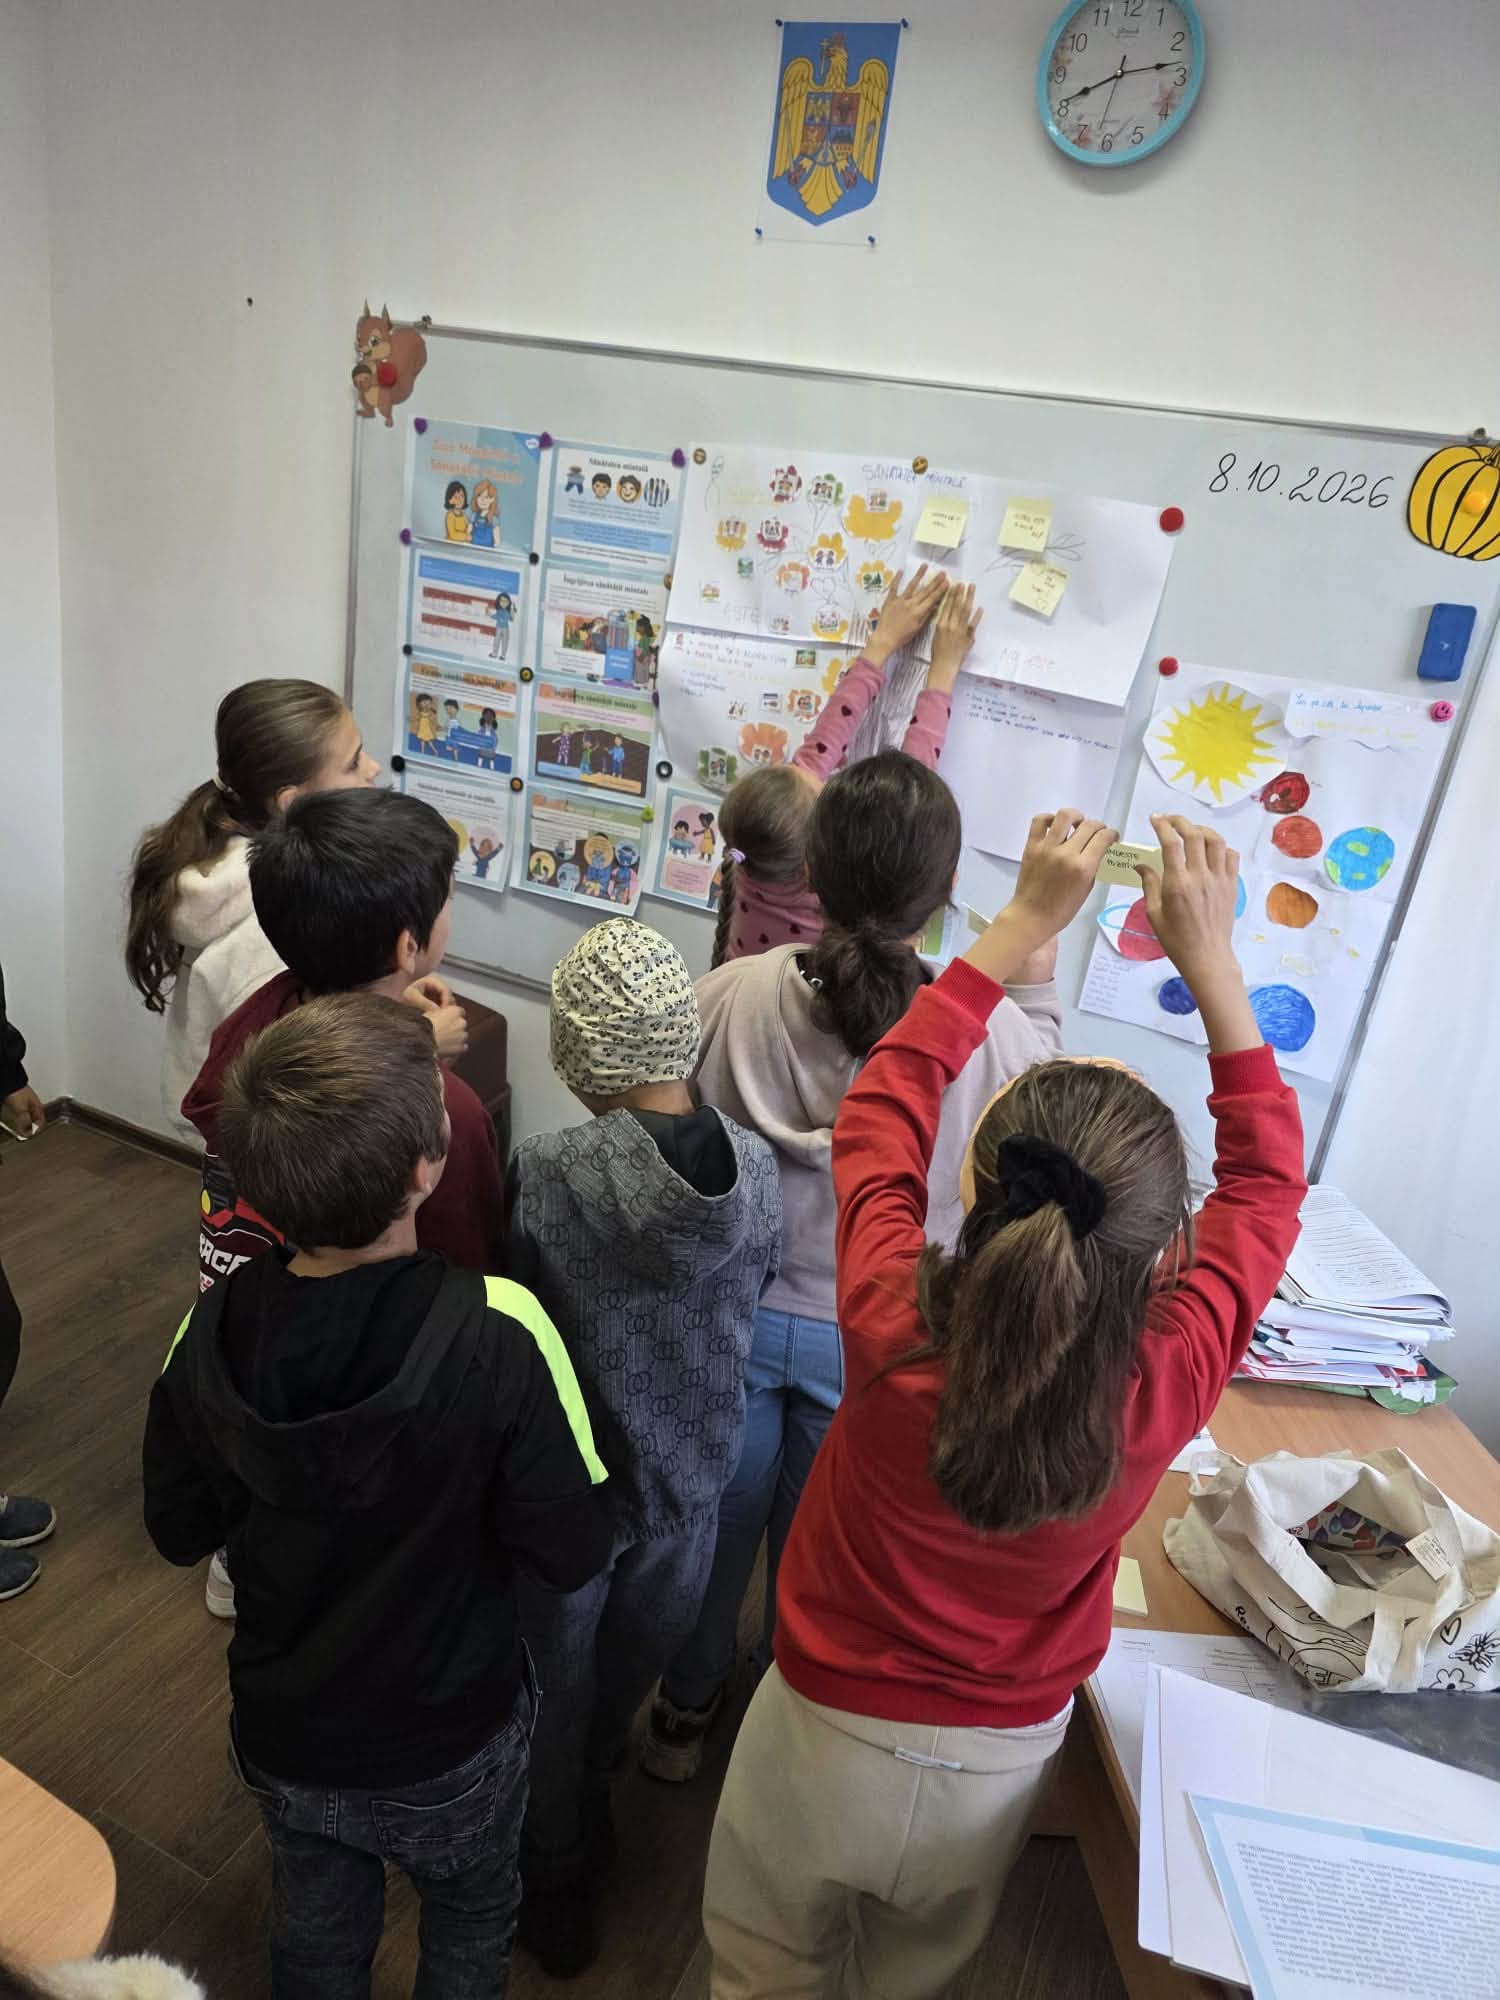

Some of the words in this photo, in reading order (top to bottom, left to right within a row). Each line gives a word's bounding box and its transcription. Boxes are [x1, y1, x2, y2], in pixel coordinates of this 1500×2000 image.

[1093, 8, 1111, 26] 11
[1123, 0, 1143, 17] 12
[1156, 8, 1165, 26] 1
[1069, 33, 1088, 53] 10
[1170, 31, 1185, 52] 2
[1054, 65, 1067, 85] 9
[1174, 67, 1187, 87] 3
[1057, 99, 1070, 118] 8
[1158, 101, 1170, 121] 4
[1077, 124, 1089, 142] 7
[1101, 133, 1114, 152] 6
[1131, 126, 1145, 145] 5
[1208, 452, 1395, 509] 8.10.2026
